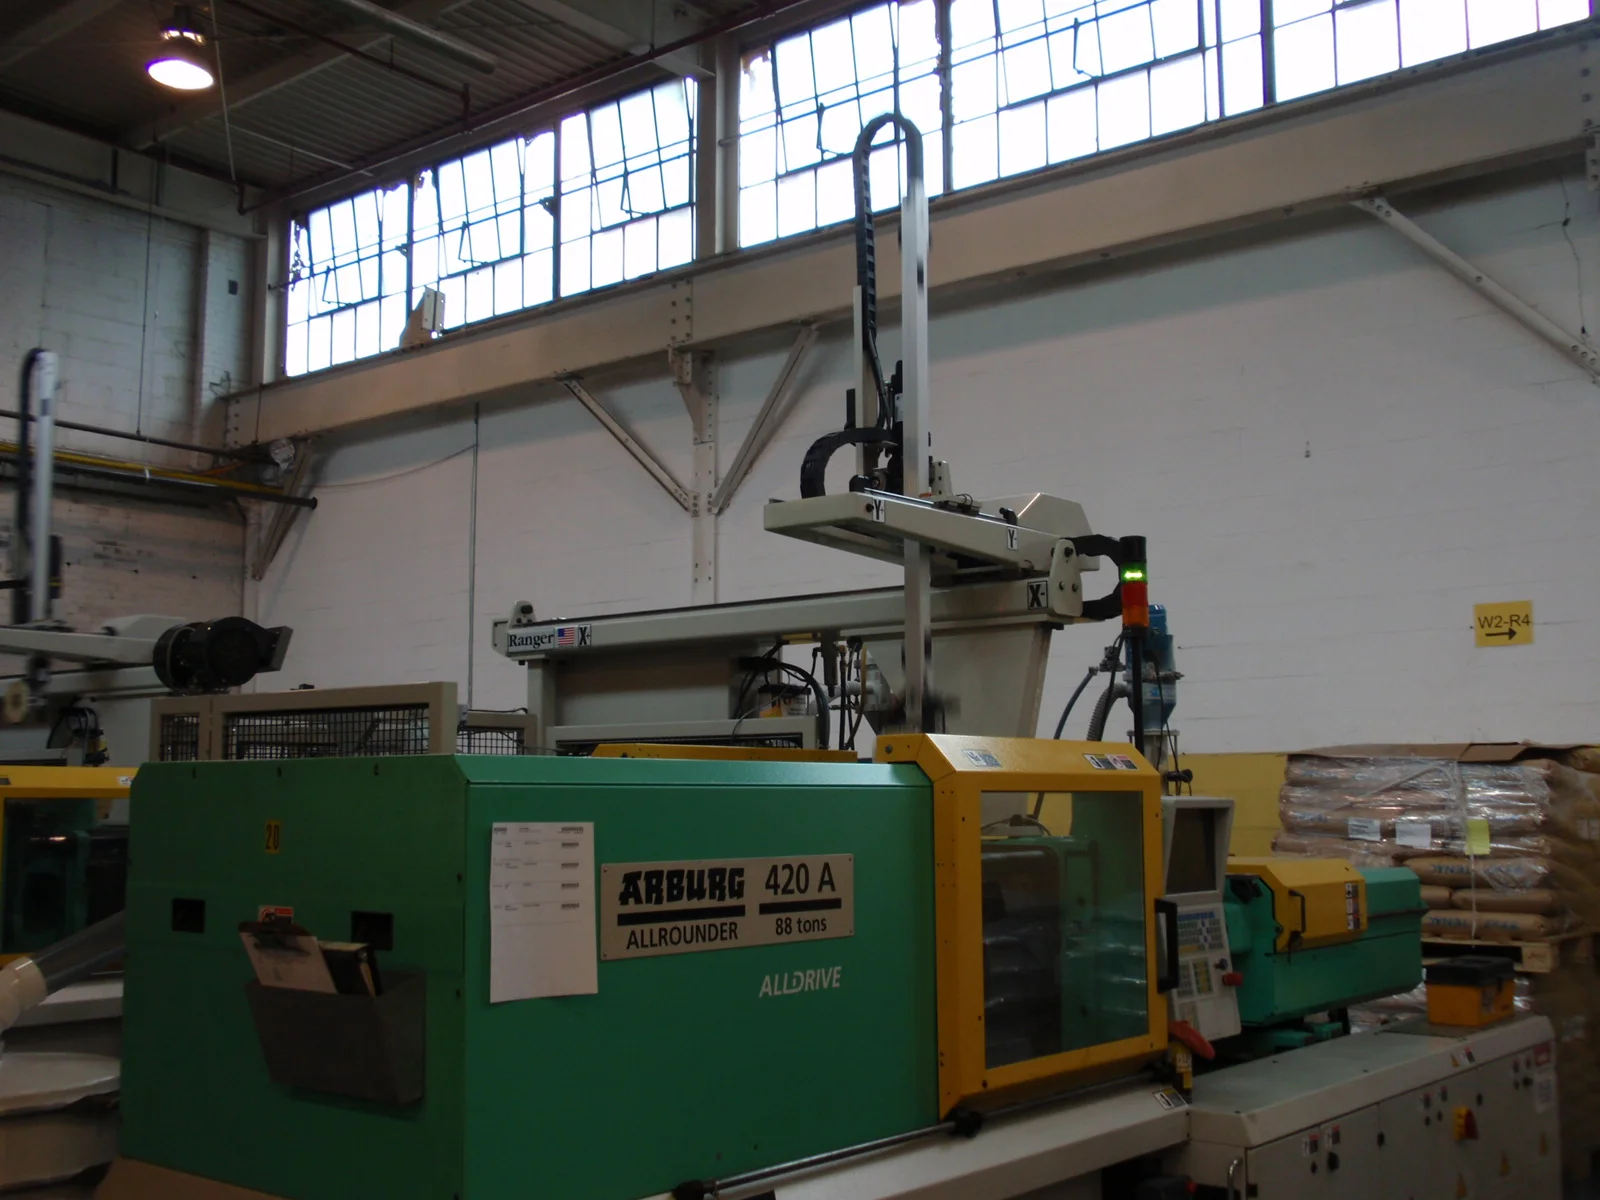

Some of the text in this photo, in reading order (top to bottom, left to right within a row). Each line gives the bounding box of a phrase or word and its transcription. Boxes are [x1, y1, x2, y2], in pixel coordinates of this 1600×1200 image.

[1478, 614, 1531, 629] W2-R4
[508, 633, 554, 649] Ranger
[266, 824, 280, 850] 20
[619, 867, 745, 906] ARBURG
[765, 861, 836, 895] 420 A
[626, 922, 738, 950] ALLROUNDER
[775, 916, 827, 936] 88 tons
[759, 966, 842, 998] ALLDRIVE
